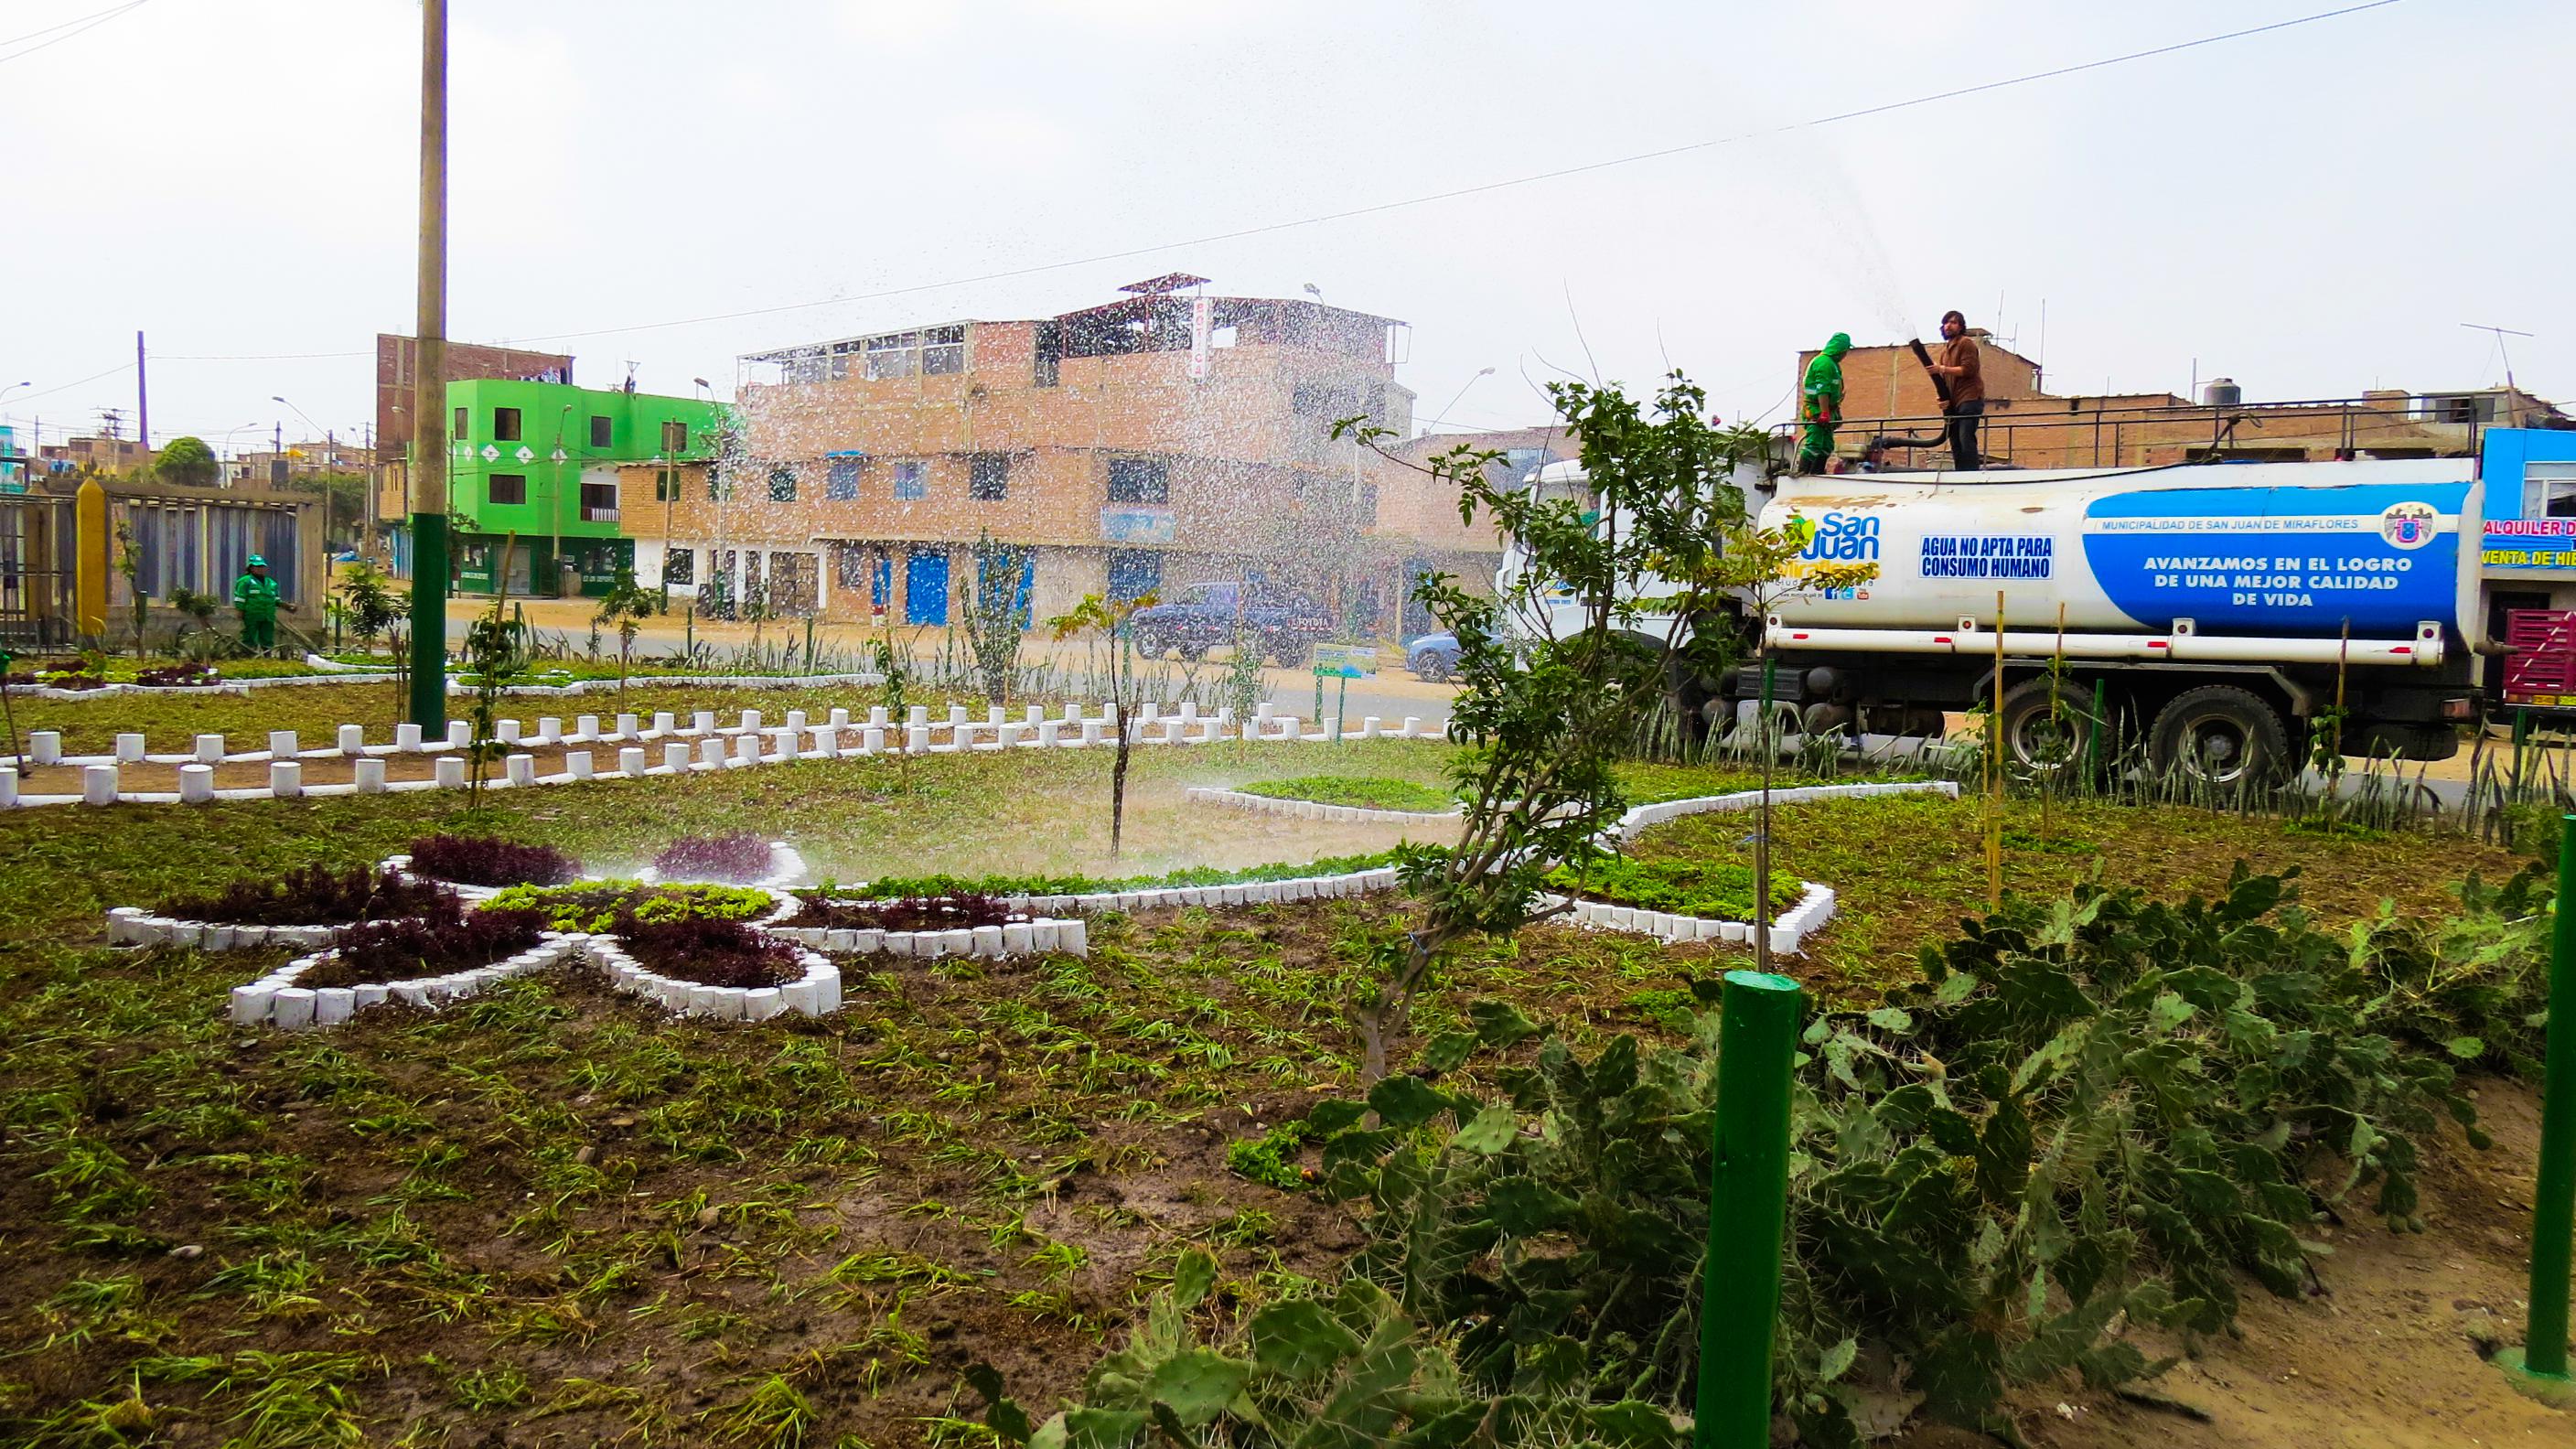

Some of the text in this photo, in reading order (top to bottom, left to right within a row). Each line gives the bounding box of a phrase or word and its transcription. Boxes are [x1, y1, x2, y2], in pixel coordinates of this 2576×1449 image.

[1821, 512, 1880, 537] San
[2102, 520, 2358, 530] MUNICIPALIDAD DE SAN JUAN DE MIRAFLORES
[2483, 521, 2561, 535] ALQUILER
[1801, 531, 1880, 560] Juan
[1922, 537, 2052, 557] AGUA NO APTA PARA
[2143, 557, 2412, 572] AVANZAMOS EN EL LOGRO
[2481, 550, 2528, 564] VENTA
[2532, 552, 2551, 565] DE
[1923, 557, 2050, 578] CONSUMO HUMANO
[2154, 574, 2399, 590] DE UNA MEJOR CALIDAD
[2232, 593, 2313, 606] DE VIDA
